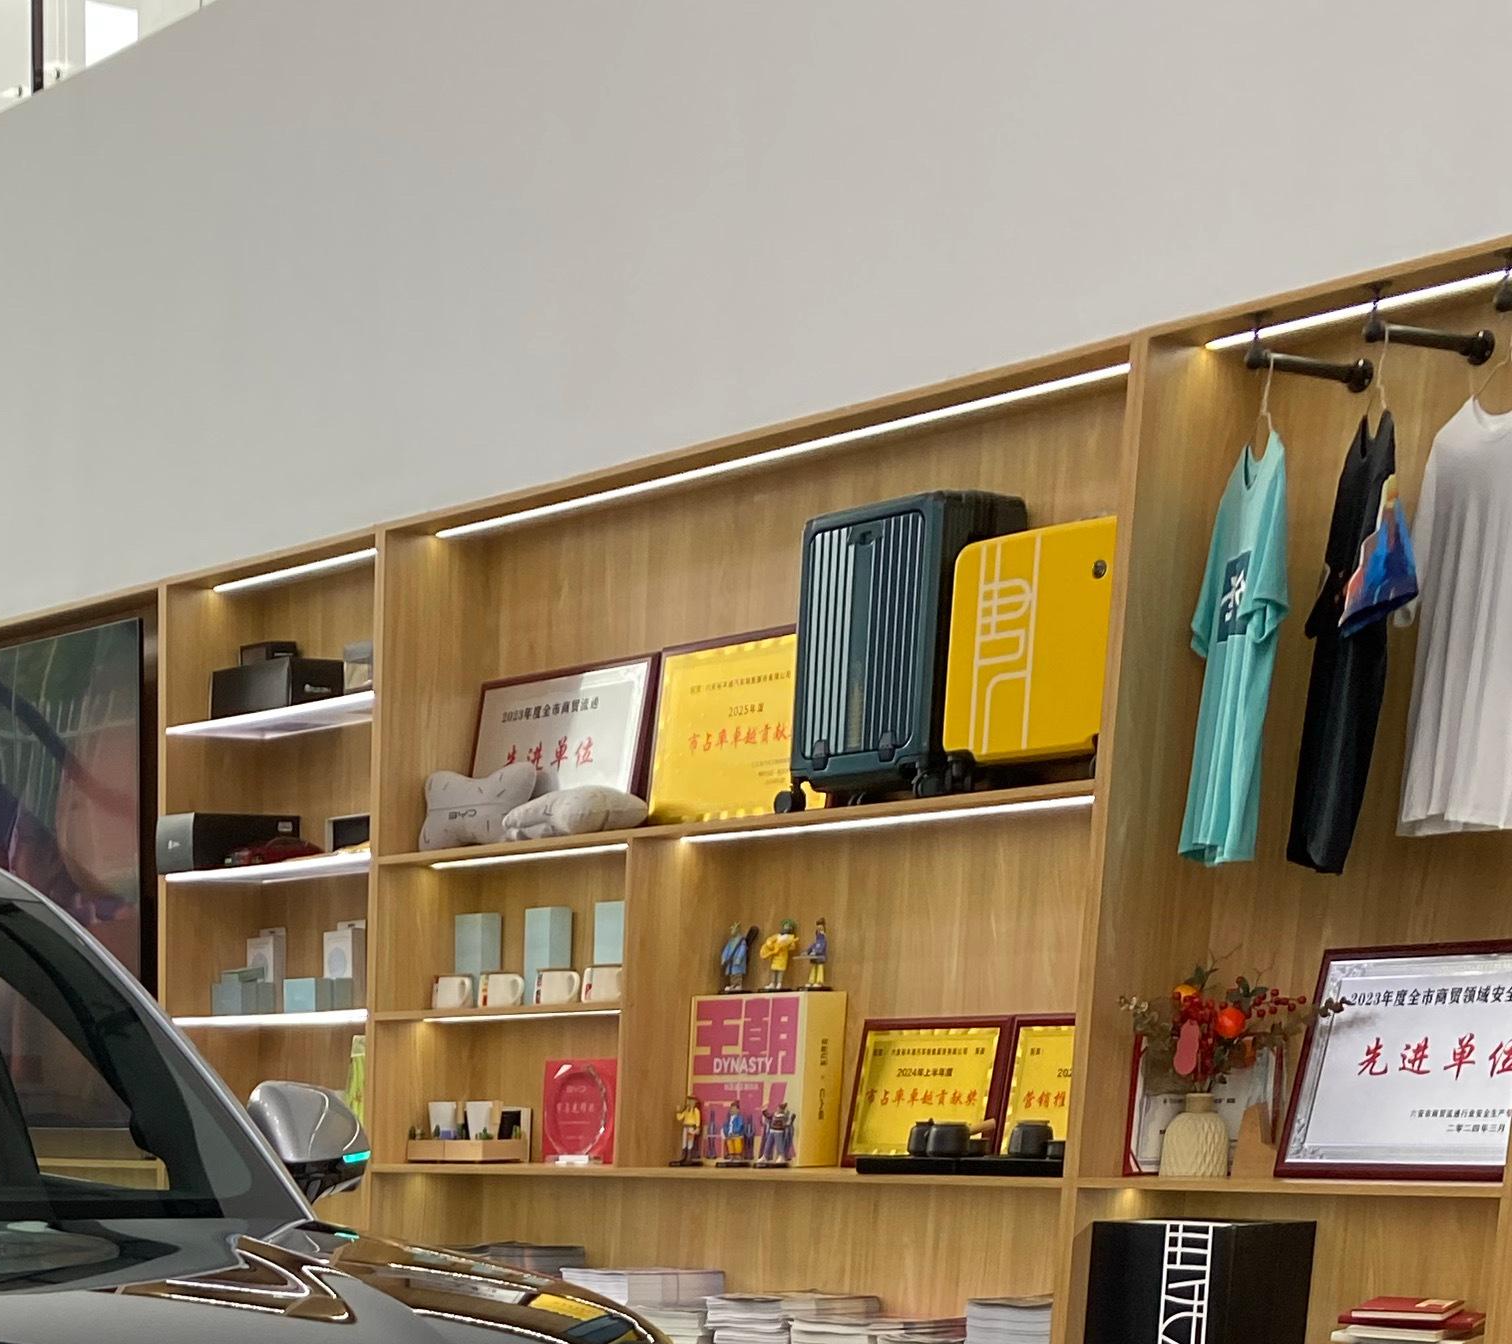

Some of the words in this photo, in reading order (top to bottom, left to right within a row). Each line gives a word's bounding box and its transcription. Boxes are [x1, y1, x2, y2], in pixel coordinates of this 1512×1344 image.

[728, 703, 764, 717] 2025年度
[688, 721, 792, 756] 市占率卓越贡献
[713, 1056, 774, 1074] DYNASTY
[896, 1067, 954, 1078] 2024年上半年度
[866, 1087, 979, 1108] 市占率卓越贡献奖
[1446, 1123, 1505, 1133] 二零二四年三月
